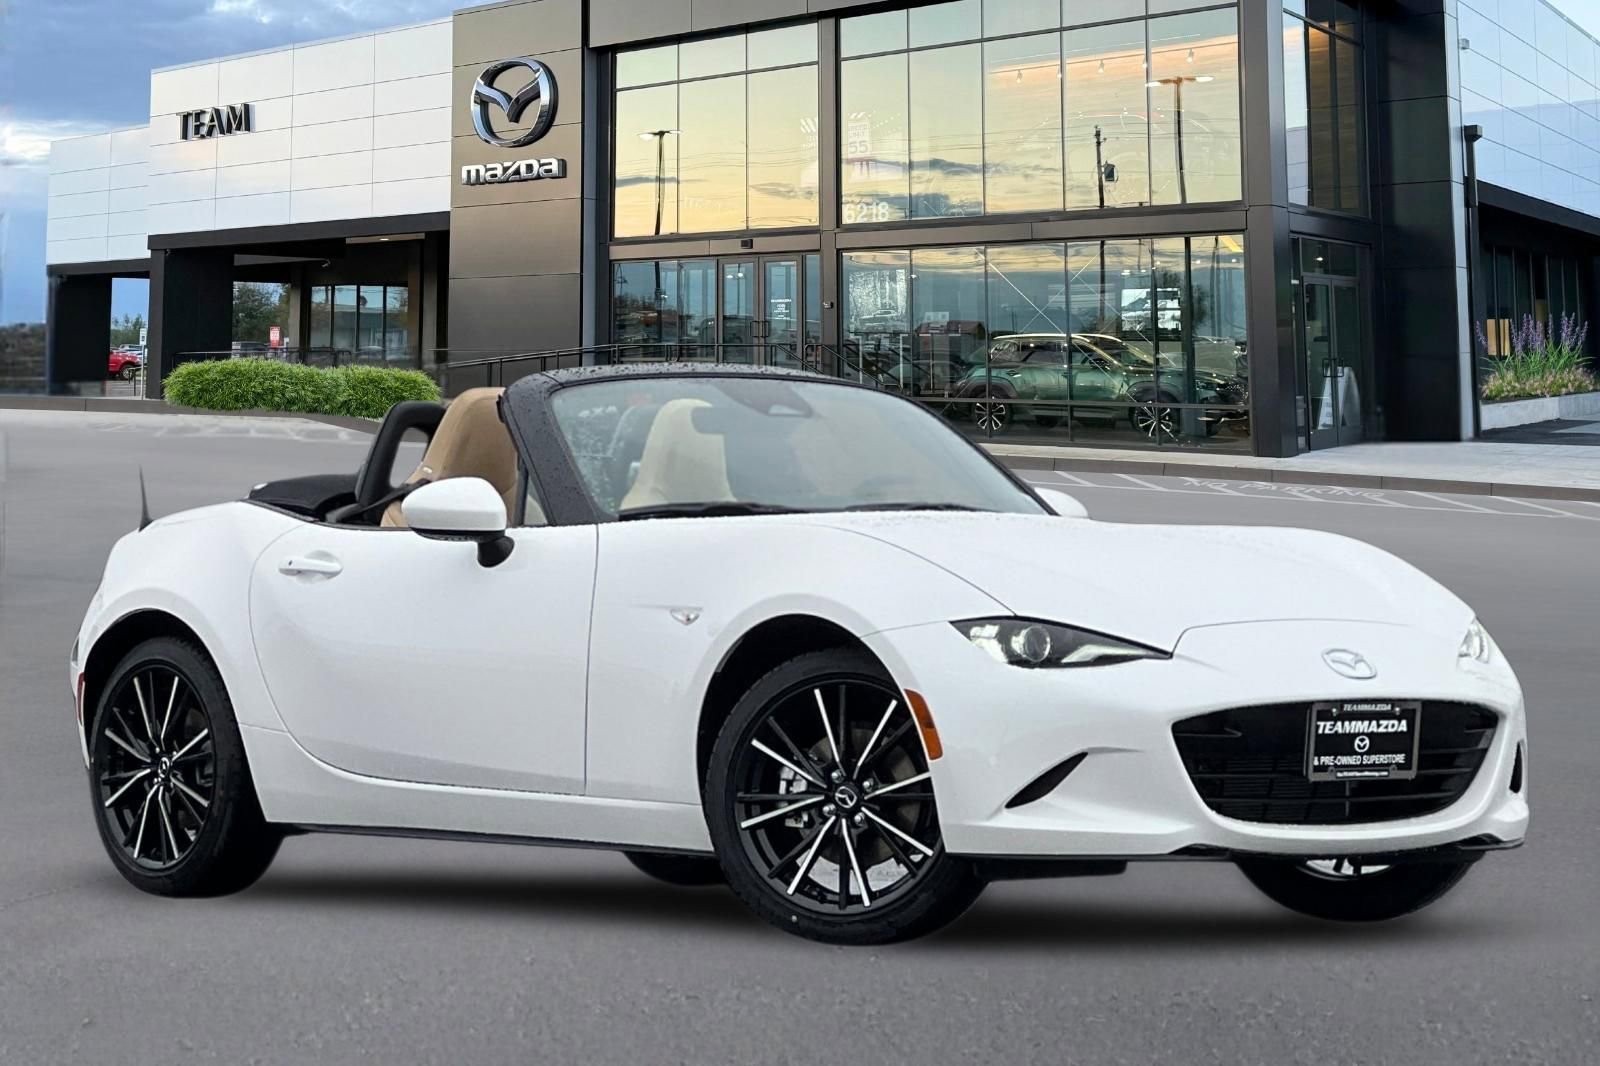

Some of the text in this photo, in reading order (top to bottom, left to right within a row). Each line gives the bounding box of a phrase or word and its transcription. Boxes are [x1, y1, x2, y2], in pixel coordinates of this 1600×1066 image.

[176, 102, 251, 140] TEAM
[845, 200, 889, 223] 6218
[1343, 703, 1392, 711] TEAMMAZDA
[1316, 719, 1408, 734] TEAMMAZDA
[1320, 755, 1362, 766] PRE-OWNED
[1362, 753, 1406, 765] SUPERSTORE
